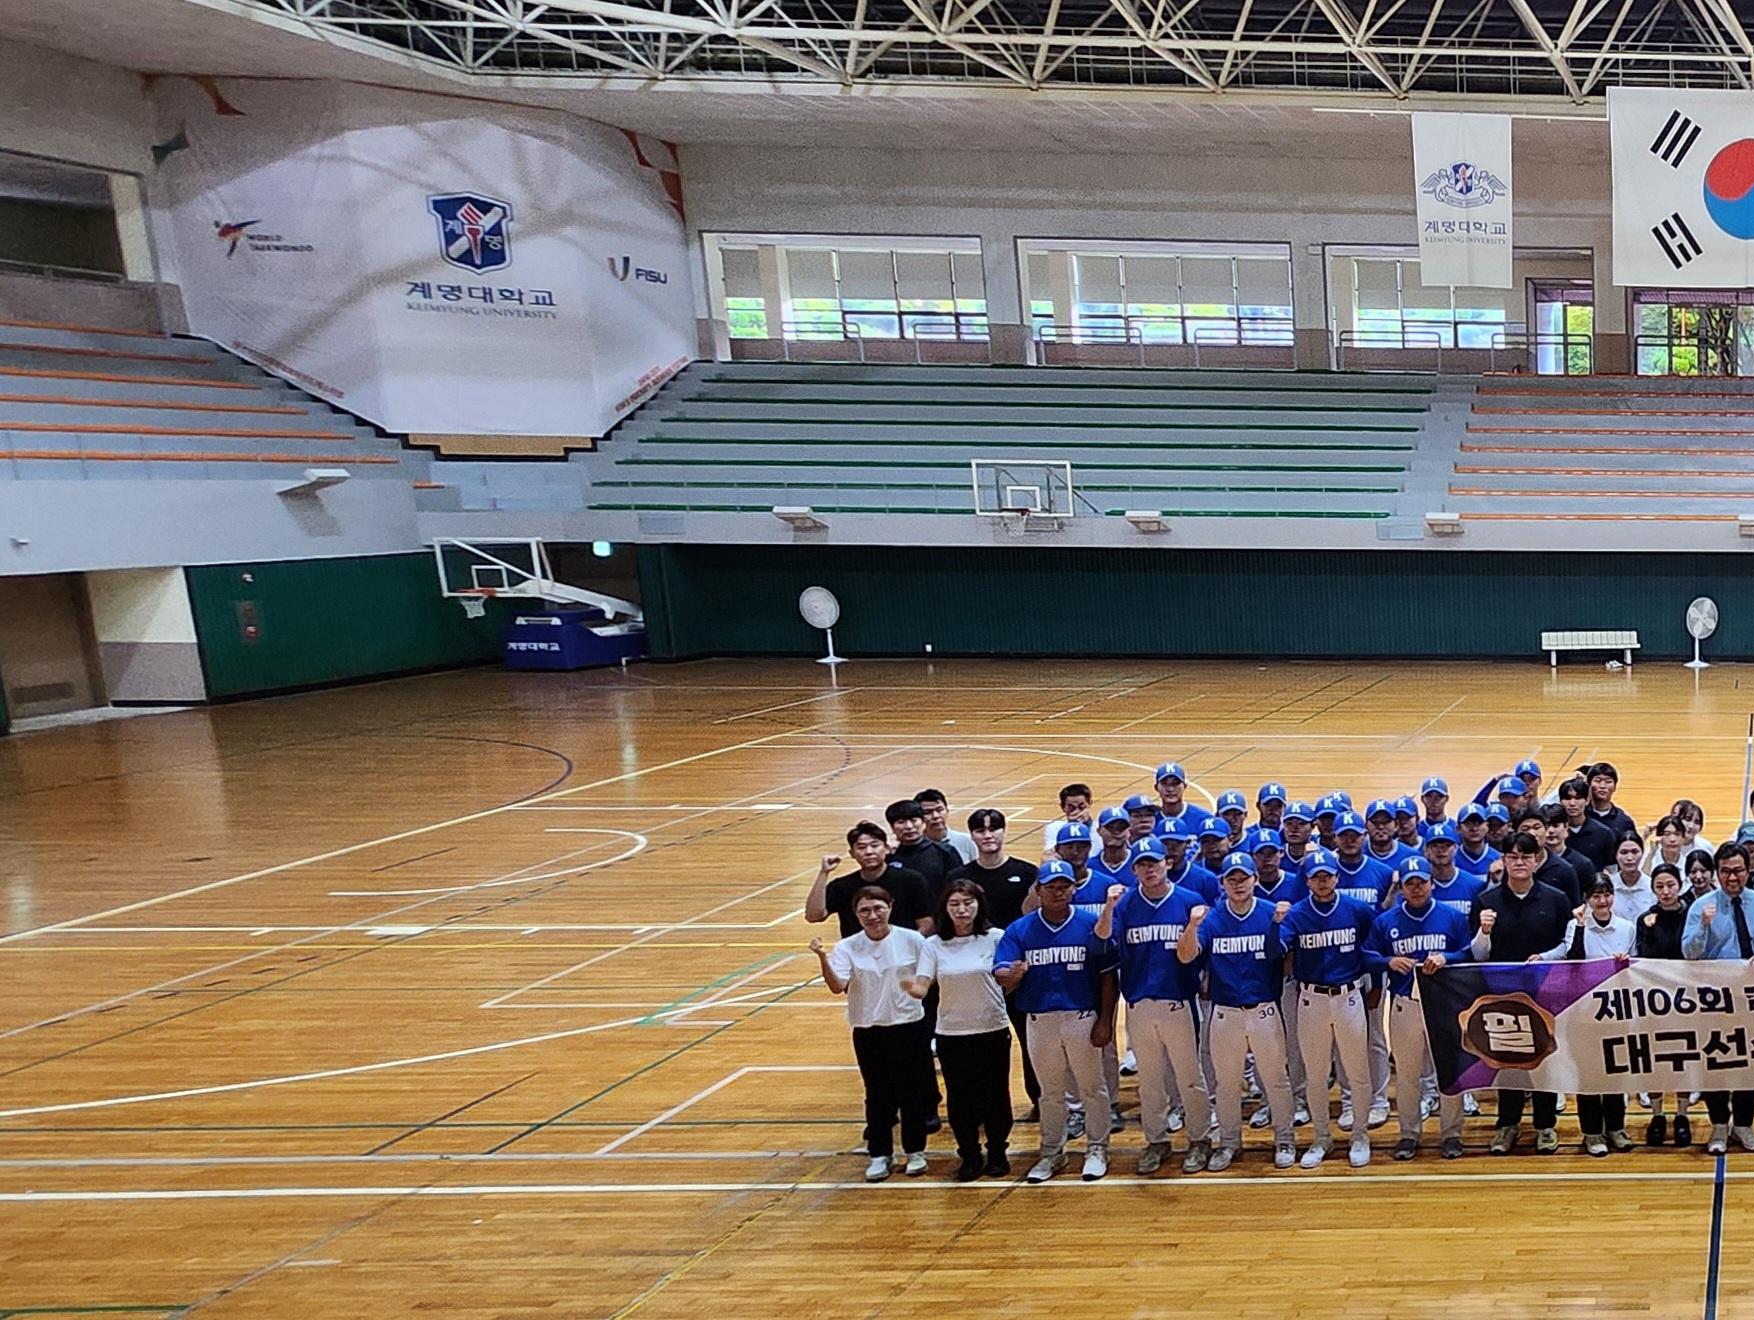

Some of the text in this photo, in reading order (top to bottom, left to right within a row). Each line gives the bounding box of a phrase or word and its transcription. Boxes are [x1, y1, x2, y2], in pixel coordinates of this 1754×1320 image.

[1424, 220, 1507, 235] 계명대학교
[635, 268, 668, 285] FISU
[406, 281, 557, 307] 계명대학교
[407, 302, 558, 320] KEIMYUNG UNIVERSITY
[1166, 763, 1176, 773] K
[1429, 777, 1438, 787] K
[1503, 778, 1512, 788] K
[1270, 785, 1279, 795] K
[1140, 795, 1149, 805] K
[1227, 793, 1236, 804] K
[1324, 798, 1333, 808] K
[1112, 806, 1122, 816] K
[1292, 802, 1301, 813] K
[1376, 800, 1386, 810] K
[1467, 803, 1478, 814] K
[1491, 802, 1500, 812] K
[1204, 818, 1215, 829] K
[1343, 812, 1354, 824] K
[1070, 824, 1082, 837] K
[1165, 820, 1176, 832] K
[1435, 824, 1444, 836] K
[1260, 830, 1272, 841] K
[1140, 838, 1151, 851] K
[1231, 853, 1243, 865] K
[1314, 851, 1326, 864] K
[1051, 861, 1063, 873] K
[1408, 858, 1419, 870] K
[1127, 925, 1184, 944] KEIMYUNG
[1299, 928, 1356, 949] KEIMYUNG
[1212, 935, 1266, 954] KEIMYUN
[1392, 934, 1446, 956] KEIMYUNG
[1025, 946, 1087, 966] KEIMYUNG
[1168, 1000, 1185, 1012] 23
[1348, 996, 1356, 1007] 5
[1592, 986, 1735, 1021] 제106회
[1259, 1006, 1276, 1019] 30
[1482, 1012, 1536, 1054] 필
